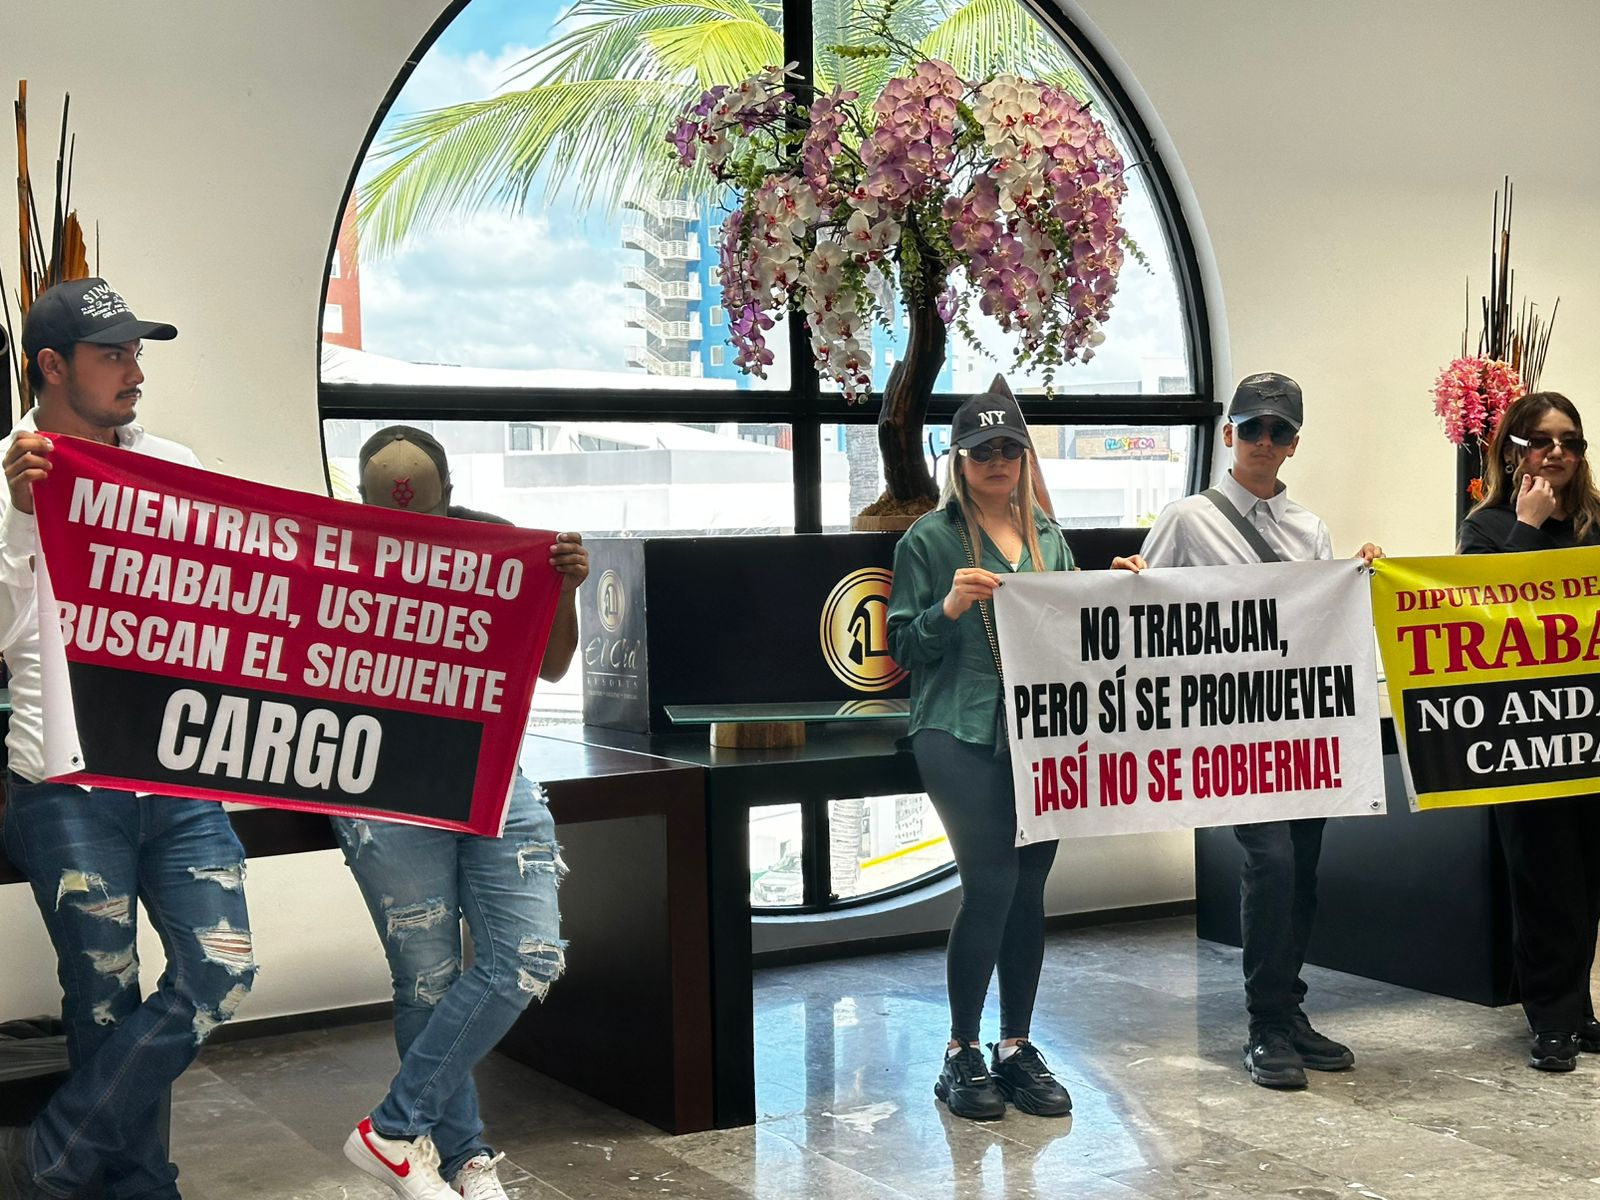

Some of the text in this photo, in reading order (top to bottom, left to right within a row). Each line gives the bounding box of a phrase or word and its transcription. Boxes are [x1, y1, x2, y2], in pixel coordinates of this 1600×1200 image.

[978, 410, 1006, 427] NY
[68, 476, 524, 600] MIENTRAS EL PUEBLO
[88, 542, 492, 653] TRABAJA, USTEDES
[1395, 575, 1600, 612] DIPUTADOS DE
[55, 599, 507, 714] BUSCAN EL SIGUIENTE
[585, 637, 640, 669] El Cid
[1080, 598, 1288, 661] NO TRABAJAN,
[1014, 664, 1356, 740] PERO SÍ SE PROMUEVEN
[1416, 686, 1600, 732] NO AND
[157, 688, 383, 794] CARGO
[1466, 732, 1600, 774] CAMP
[1032, 736, 1342, 816] ¡ASÍ NO SE GOBIERNA!
